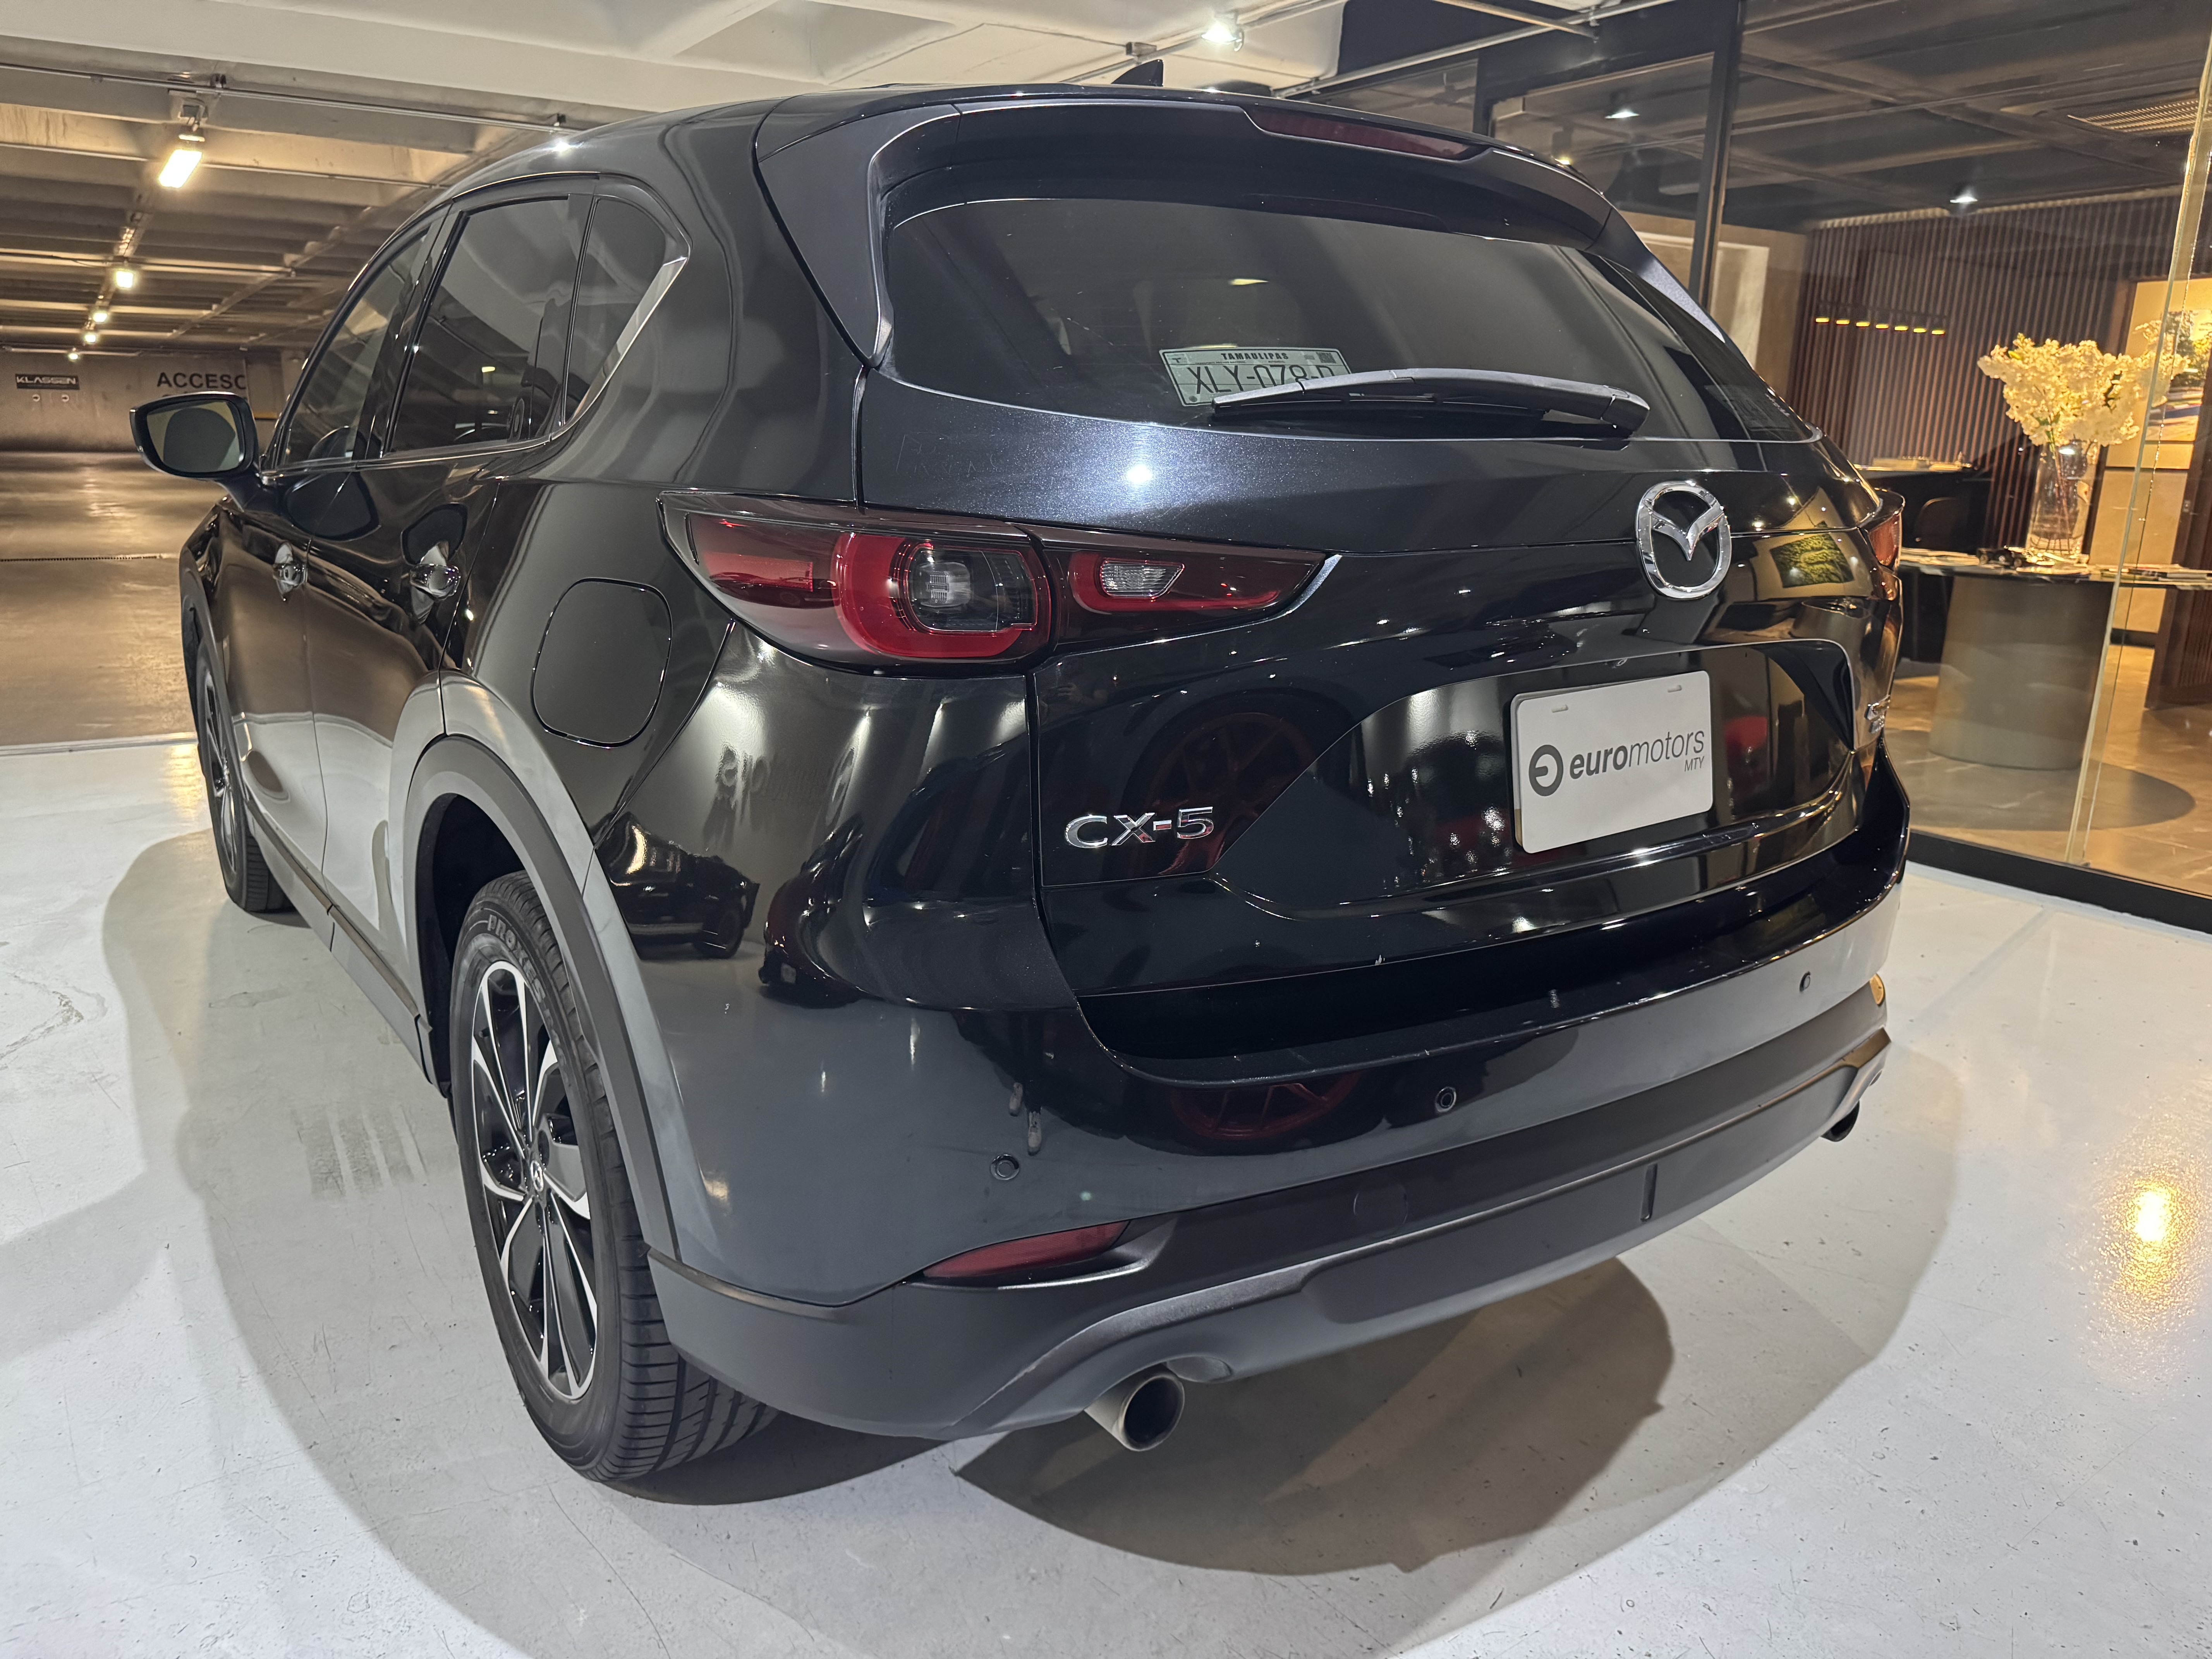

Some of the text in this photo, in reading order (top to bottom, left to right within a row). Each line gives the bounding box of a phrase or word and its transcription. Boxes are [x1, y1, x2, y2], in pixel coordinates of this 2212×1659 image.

[1569, 730, 1705, 780] euromotors
[1684, 756, 1705, 772] MTY
[1065, 806, 1214, 848] CX-5
[487, 914, 546, 1003] PROXES
